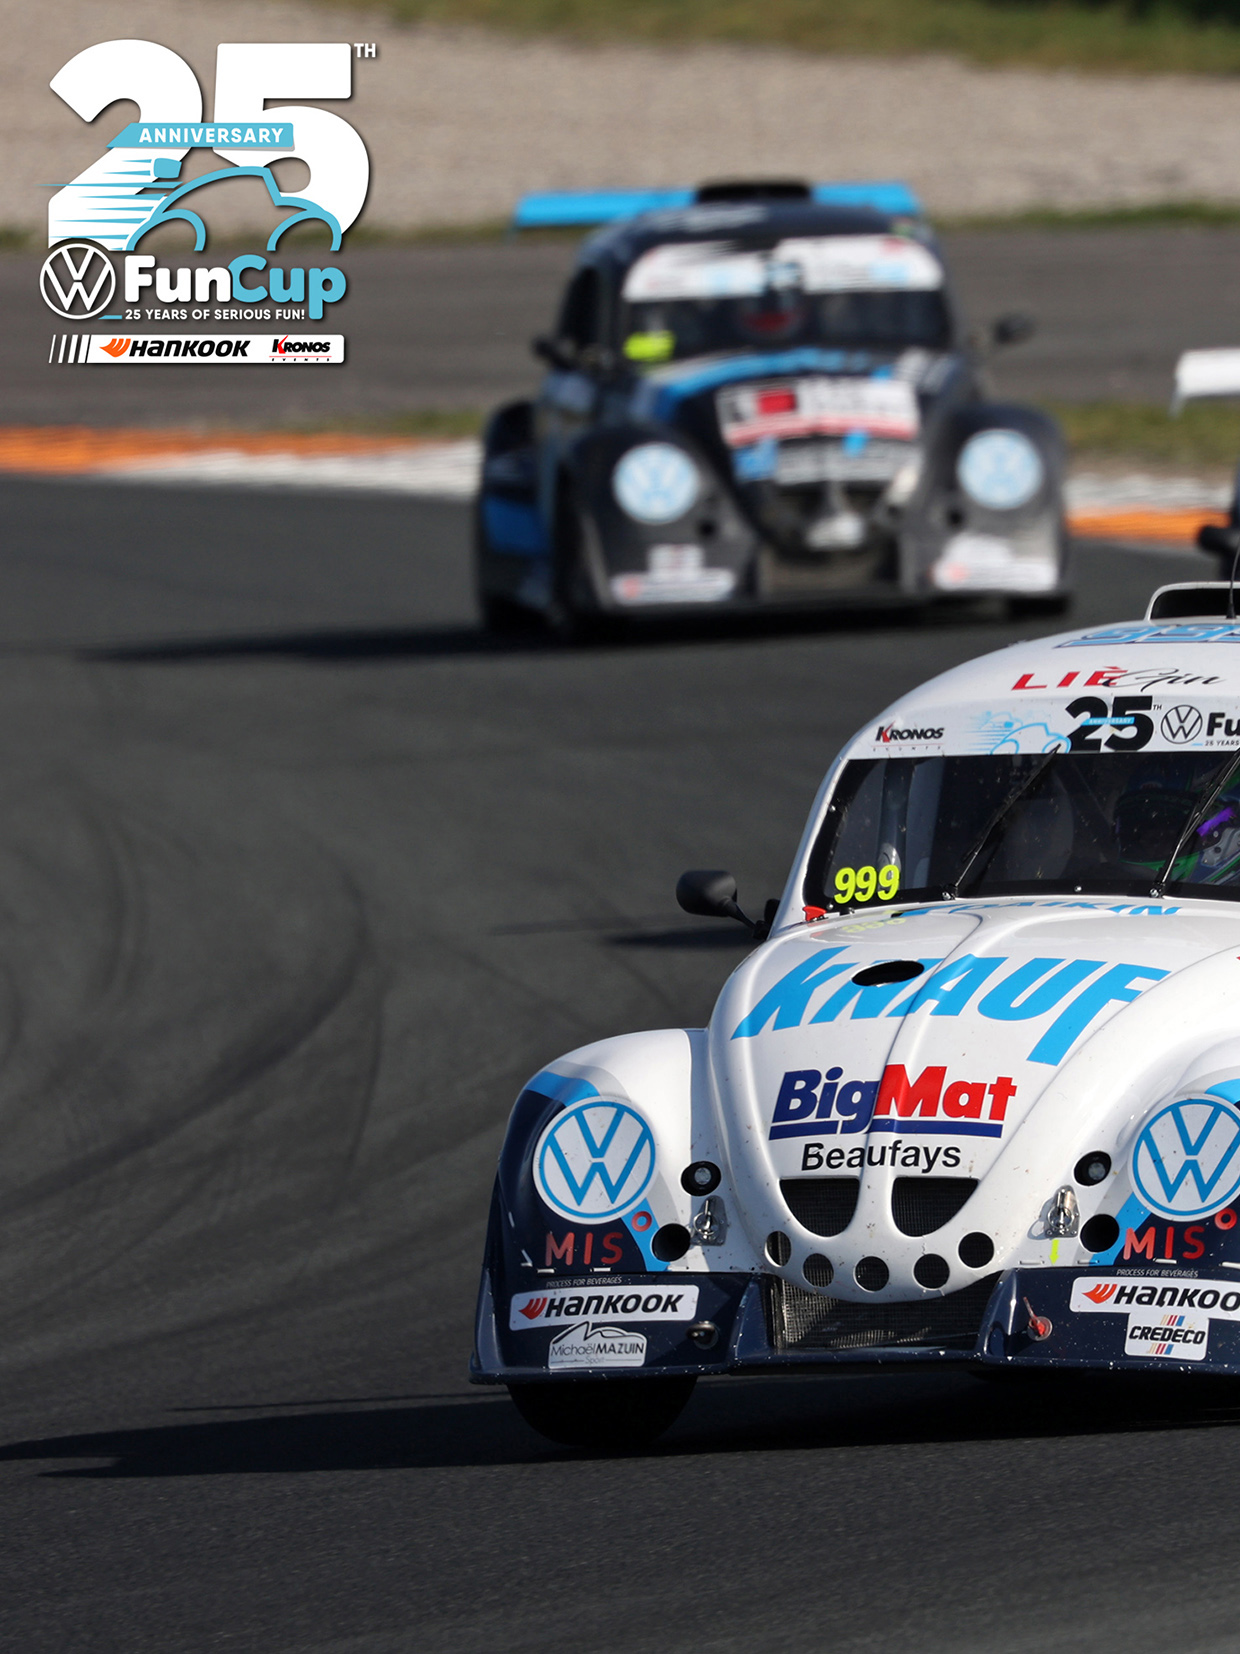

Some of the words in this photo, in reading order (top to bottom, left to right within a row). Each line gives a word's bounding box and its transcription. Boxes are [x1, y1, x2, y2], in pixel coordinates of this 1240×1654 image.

[1065, 696, 1155, 753] 25
[834, 864, 901, 903] 999
[730, 945, 1174, 1067] KNAUF
[771, 1064, 1018, 1135] BigMat
[801, 1138, 962, 1175] Beaufays
[546, 1278, 573, 1288] PROCESS
[573, 1278, 586, 1287] FOR
[586, 1276, 623, 1286] BEVERAGES
[1116, 1268, 1147, 1277] PROCESS
[1148, 1269, 1160, 1277] FOR
[1161, 1270, 1199, 1278] BEVERAGES
[1128, 1325, 1206, 1345] CREDECO
